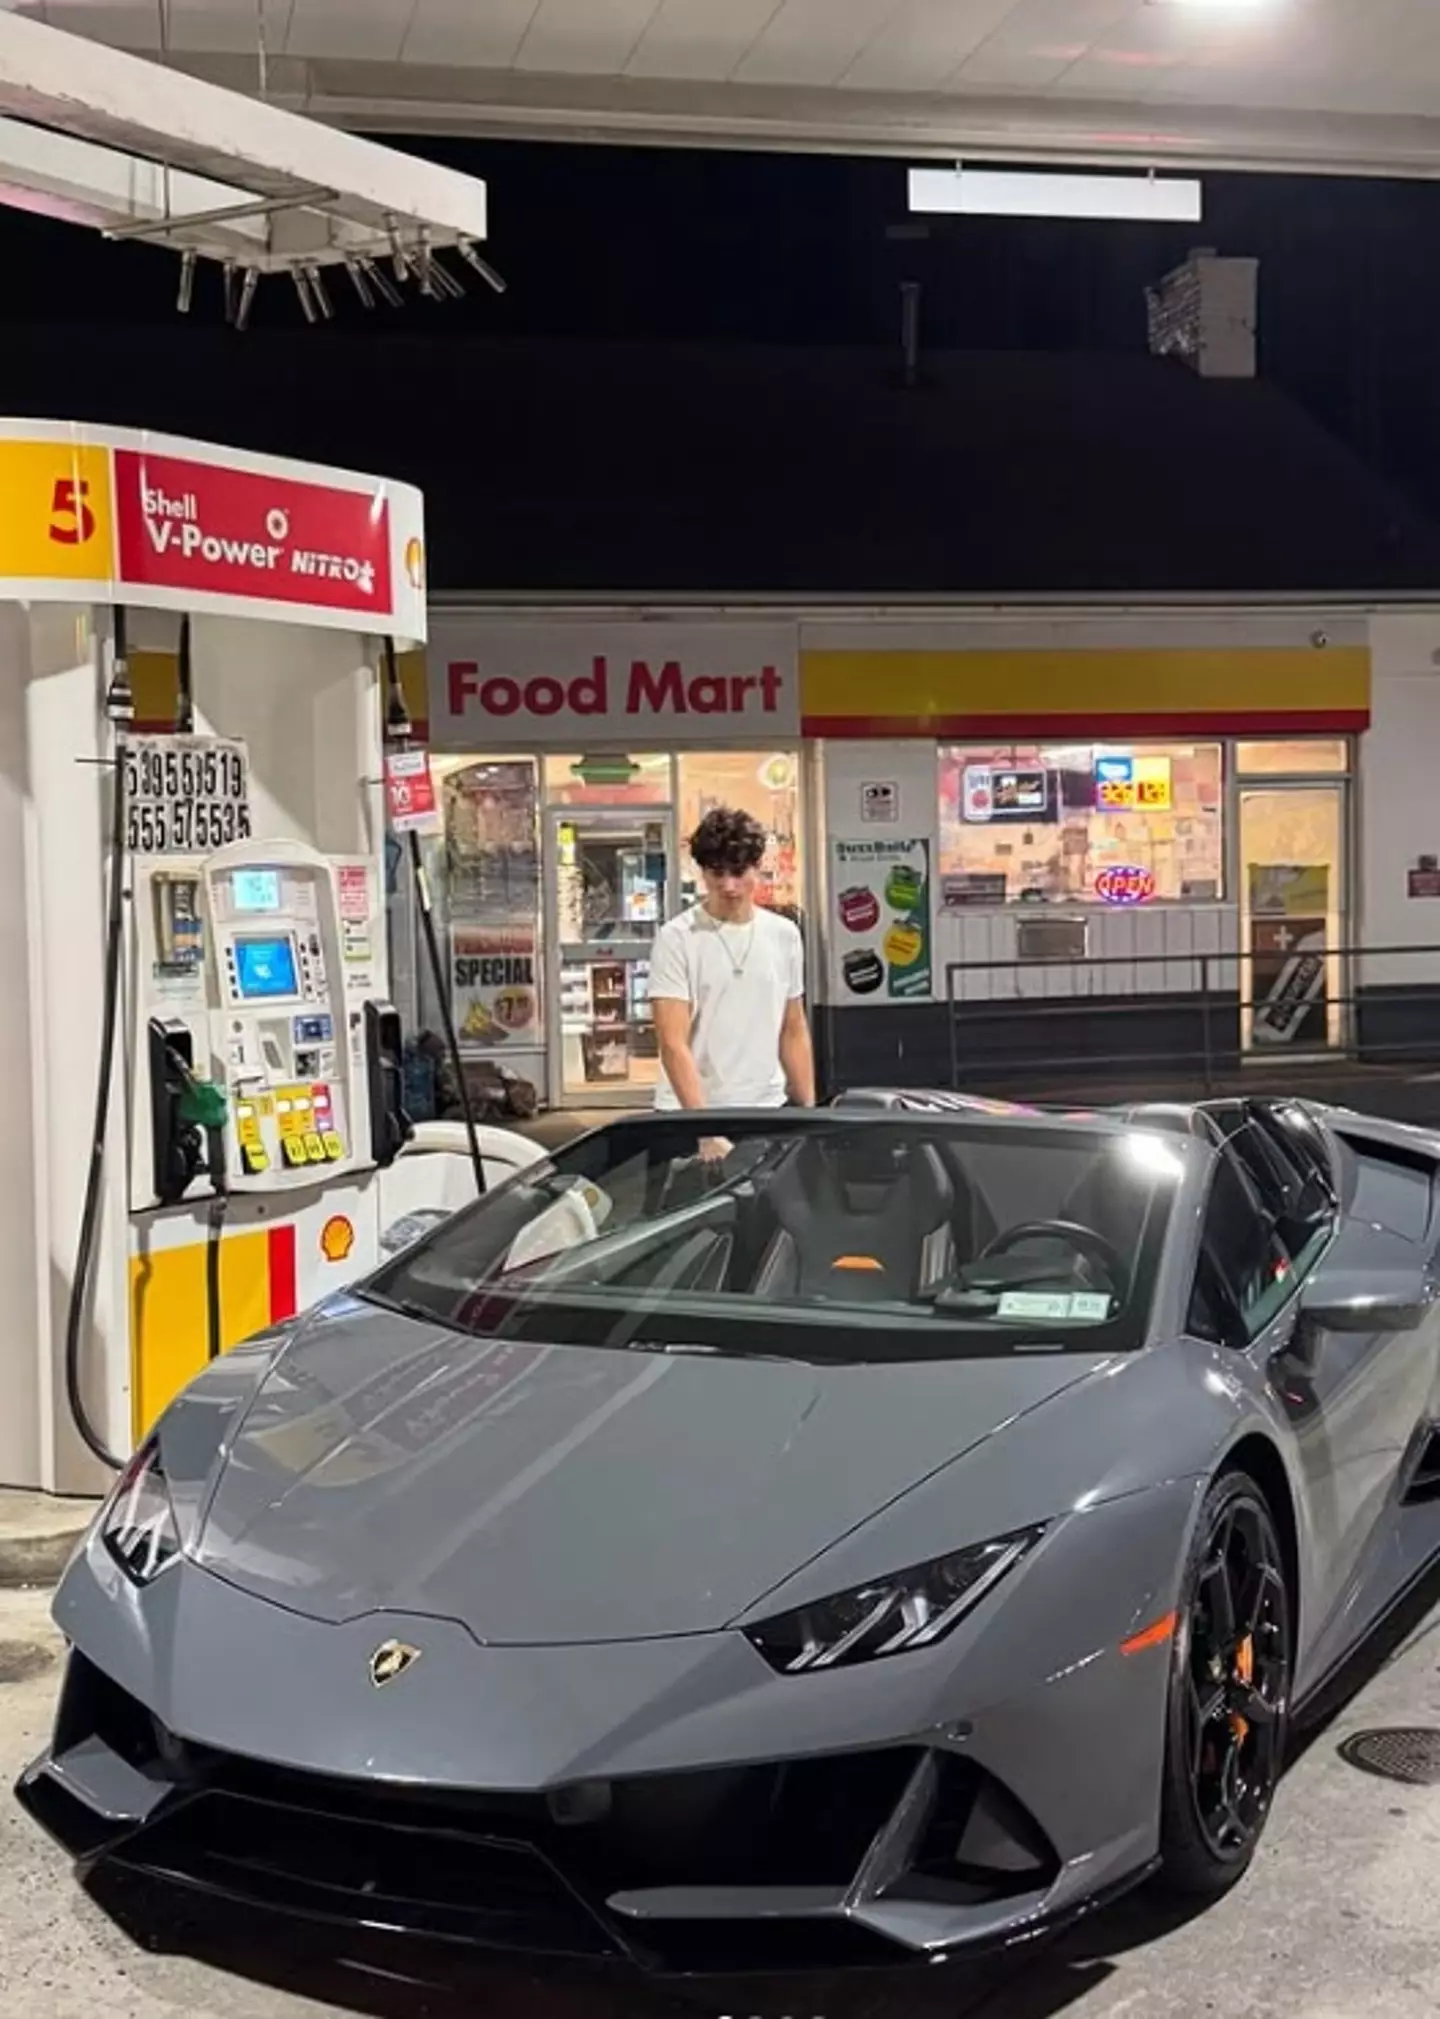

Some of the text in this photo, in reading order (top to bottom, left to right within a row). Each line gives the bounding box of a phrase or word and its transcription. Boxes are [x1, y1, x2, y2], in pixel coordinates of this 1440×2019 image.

[50, 479, 95, 544] 5
[144, 488, 197, 520] Shell
[145, 518, 279, 569] V-Power
[448, 656, 783, 716] Food Mart
[1098, 876, 1156, 893] OPEN
[455, 956, 534, 986] SPECIAL
